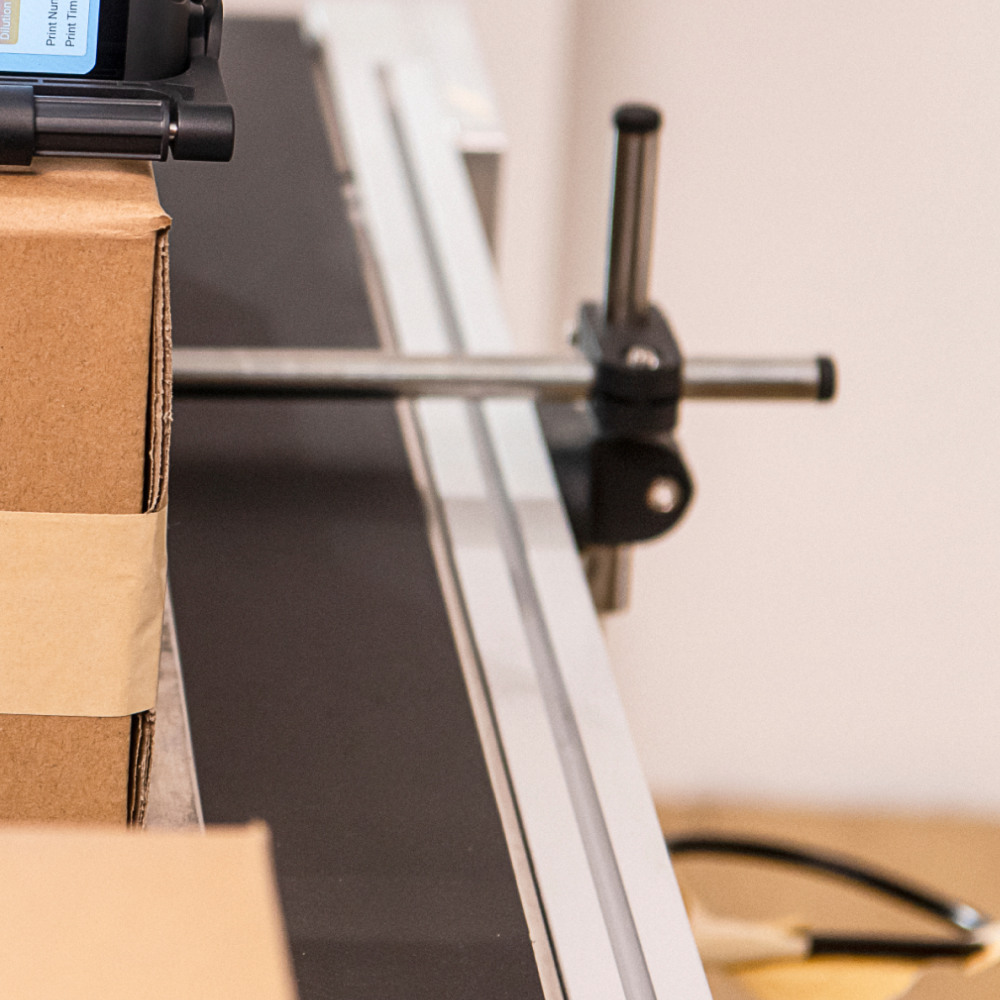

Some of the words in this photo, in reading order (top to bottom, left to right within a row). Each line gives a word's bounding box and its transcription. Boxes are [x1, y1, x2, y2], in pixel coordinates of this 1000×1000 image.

[0, 0, 12, 40] Dilution
[46, 22, 57, 47] Print
[65, 22, 76, 47] Print
